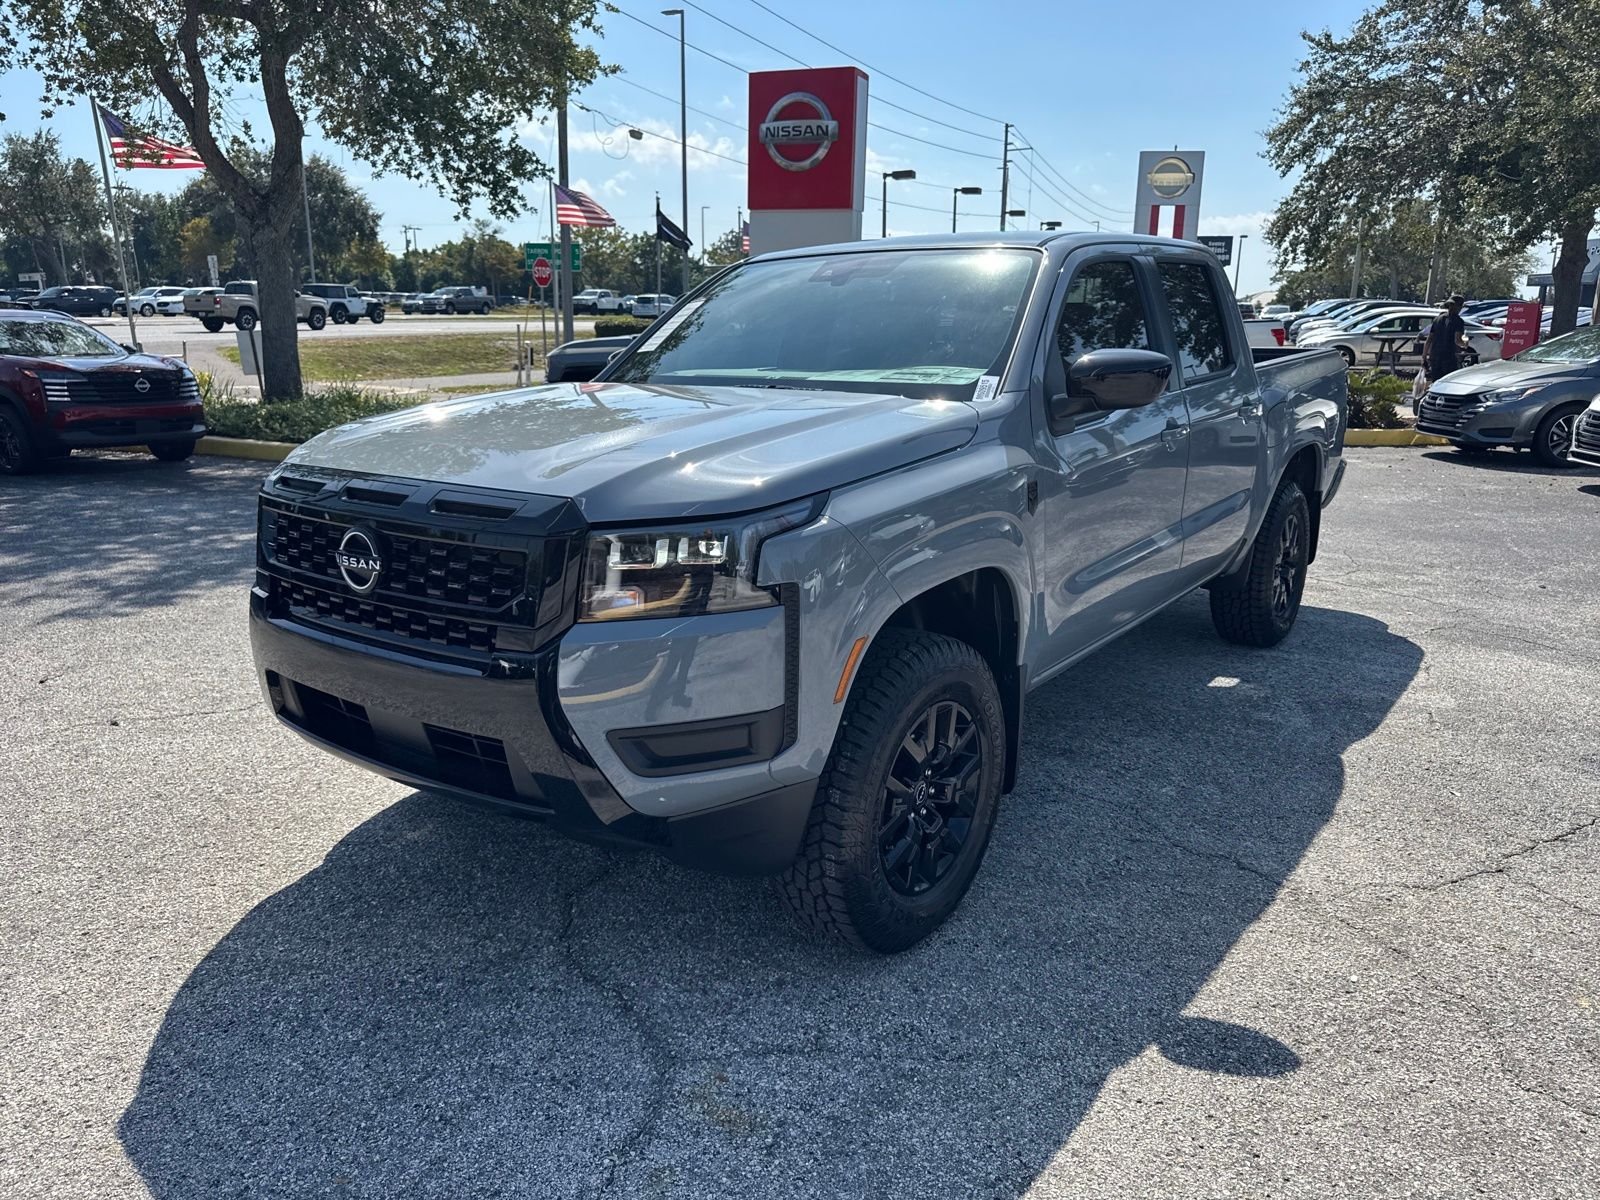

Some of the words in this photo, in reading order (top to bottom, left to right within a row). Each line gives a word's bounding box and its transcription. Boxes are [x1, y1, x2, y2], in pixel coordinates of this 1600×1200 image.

[765, 125, 829, 138] NISSAN
[534, 266, 550, 278] STOP
[335, 552, 380, 570] NISSAN
